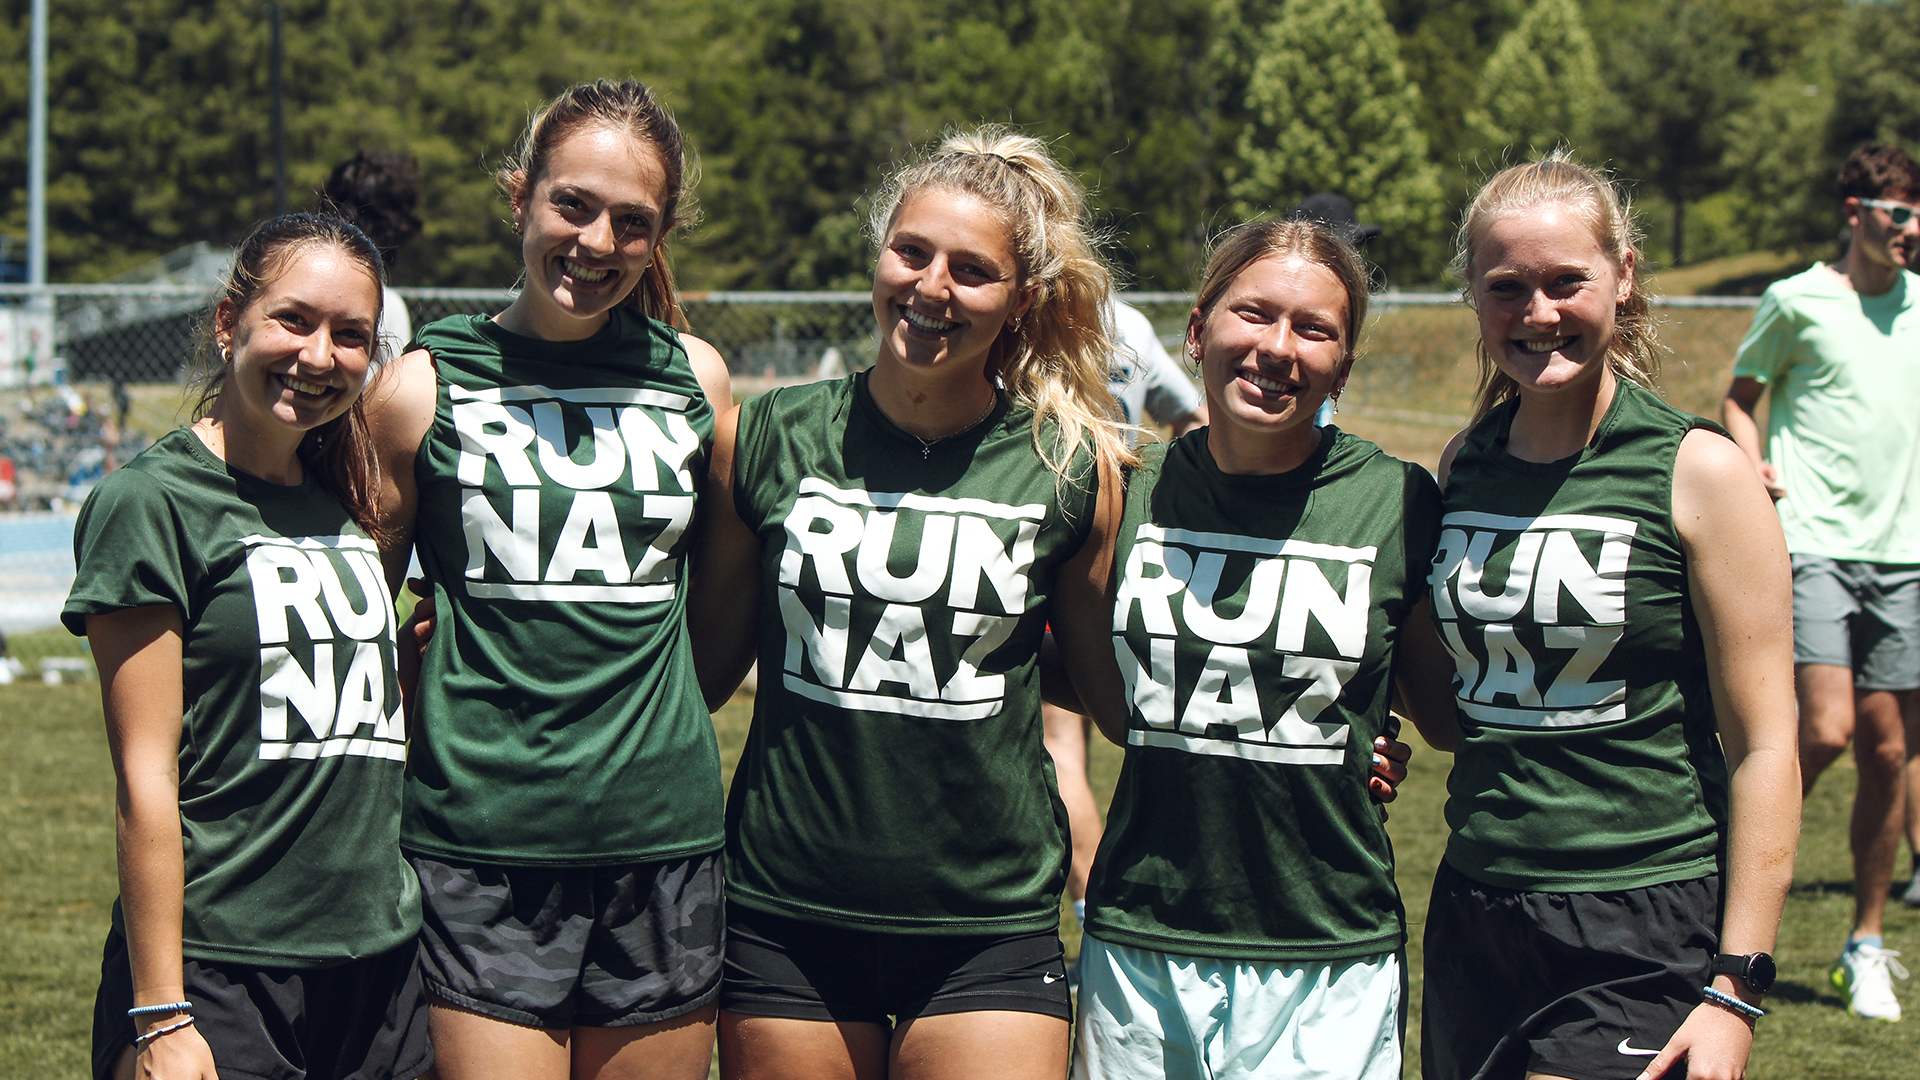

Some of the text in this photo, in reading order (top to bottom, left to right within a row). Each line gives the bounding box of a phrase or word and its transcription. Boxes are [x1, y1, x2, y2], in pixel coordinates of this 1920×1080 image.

[452, 402, 699, 492] RUN
[461, 488, 694, 584] NAZ
[779, 496, 1041, 615] RUN
[1426, 528, 1633, 624] RUN
[778, 585, 1021, 702] NAZ
[1112, 541, 1373, 659] RUN
[1112, 635, 1361, 746] NAZ
